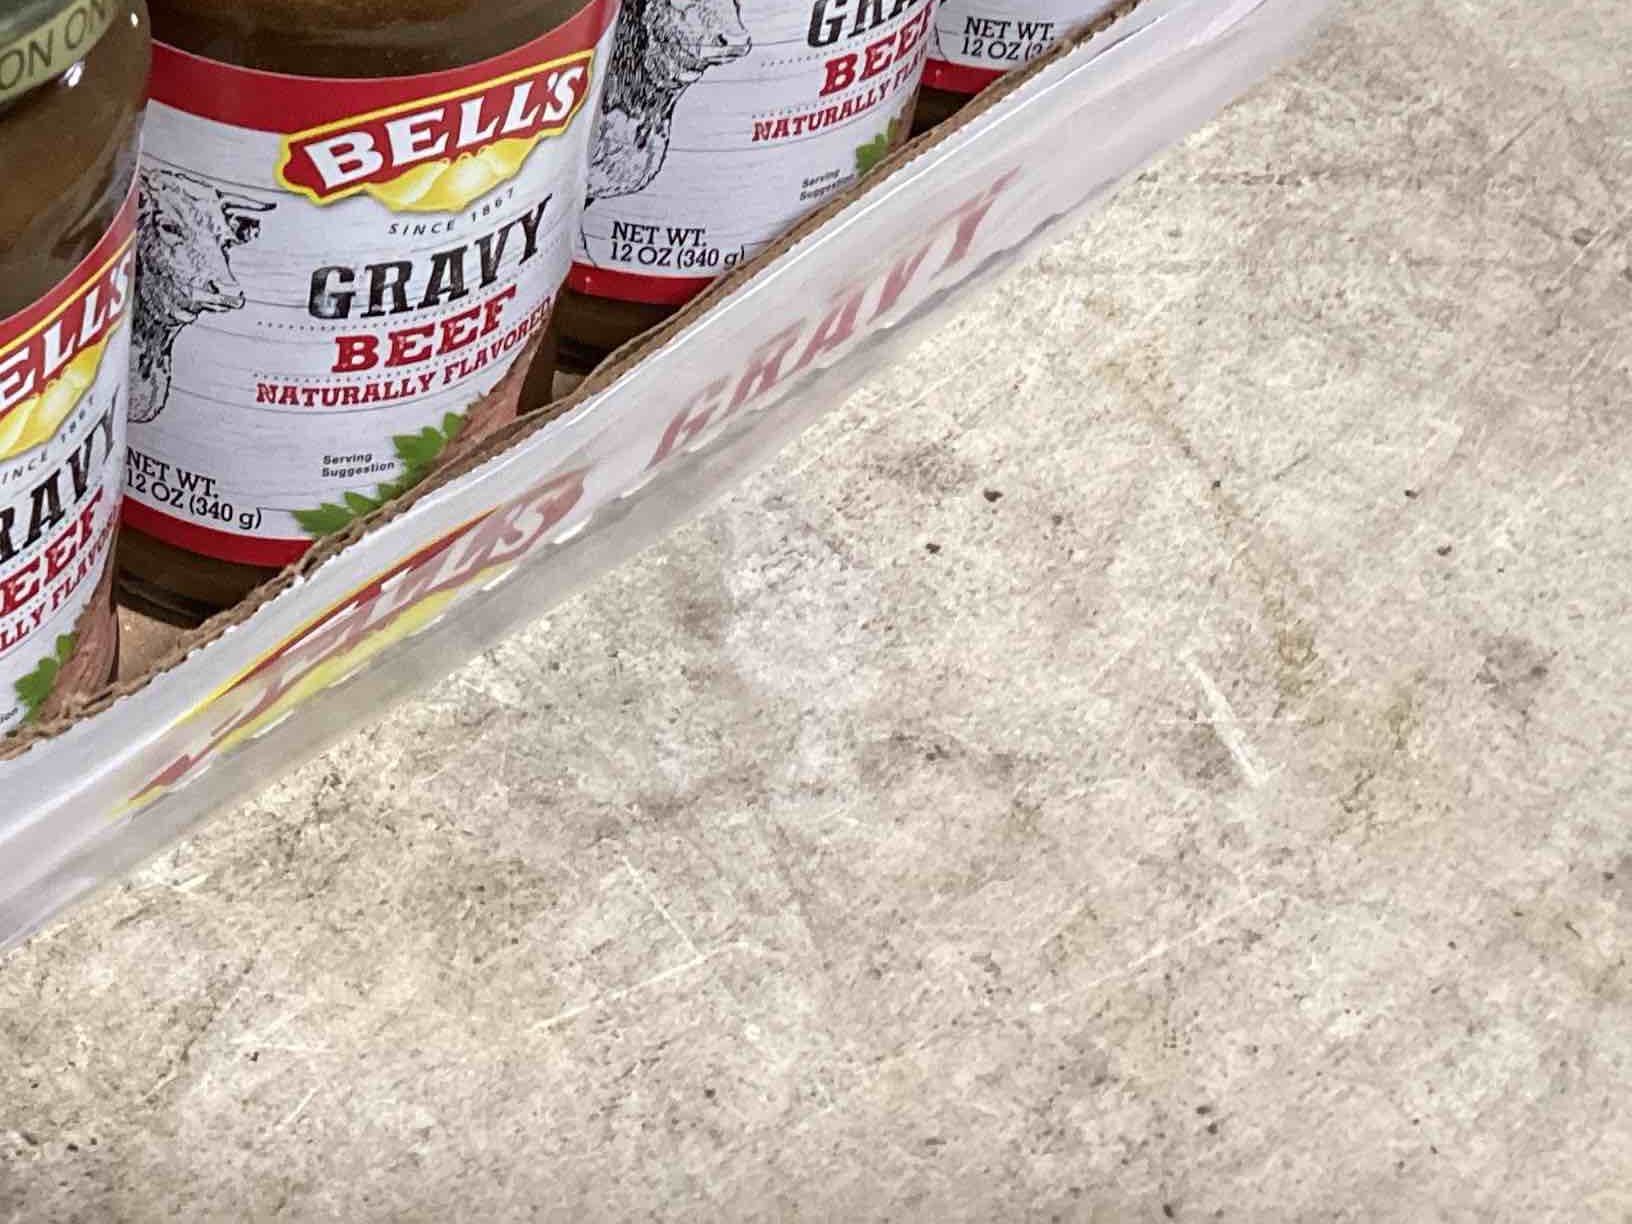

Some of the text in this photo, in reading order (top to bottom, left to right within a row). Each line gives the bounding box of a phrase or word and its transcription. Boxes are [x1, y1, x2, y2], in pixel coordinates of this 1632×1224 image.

[961, 36, 985, 56] 12
[988, 41, 1021, 61] OZ
[964, 18, 1056, 43] NET WT.
[305, 66, 584, 189] BELL'S
[752, 84, 894, 143] NATURALLY
[389, 186, 516, 237] SINCE 1867
[611, 221, 707, 247] NET WT.
[307, 193, 553, 321] GRAVY
[610, 243, 634, 261] 12
[638, 247, 672, 266] OZ
[676, 247, 719, 270] (340
[331, 284, 517, 375] BEEF
[255, 371, 437, 408] NATURALLY
[126, 446, 220, 499] NET WT.
[321, 459, 396, 478] Suggestion
[323, 451, 373, 466] Serving
[126, 470, 263, 531] 12 OZ (340 g)
